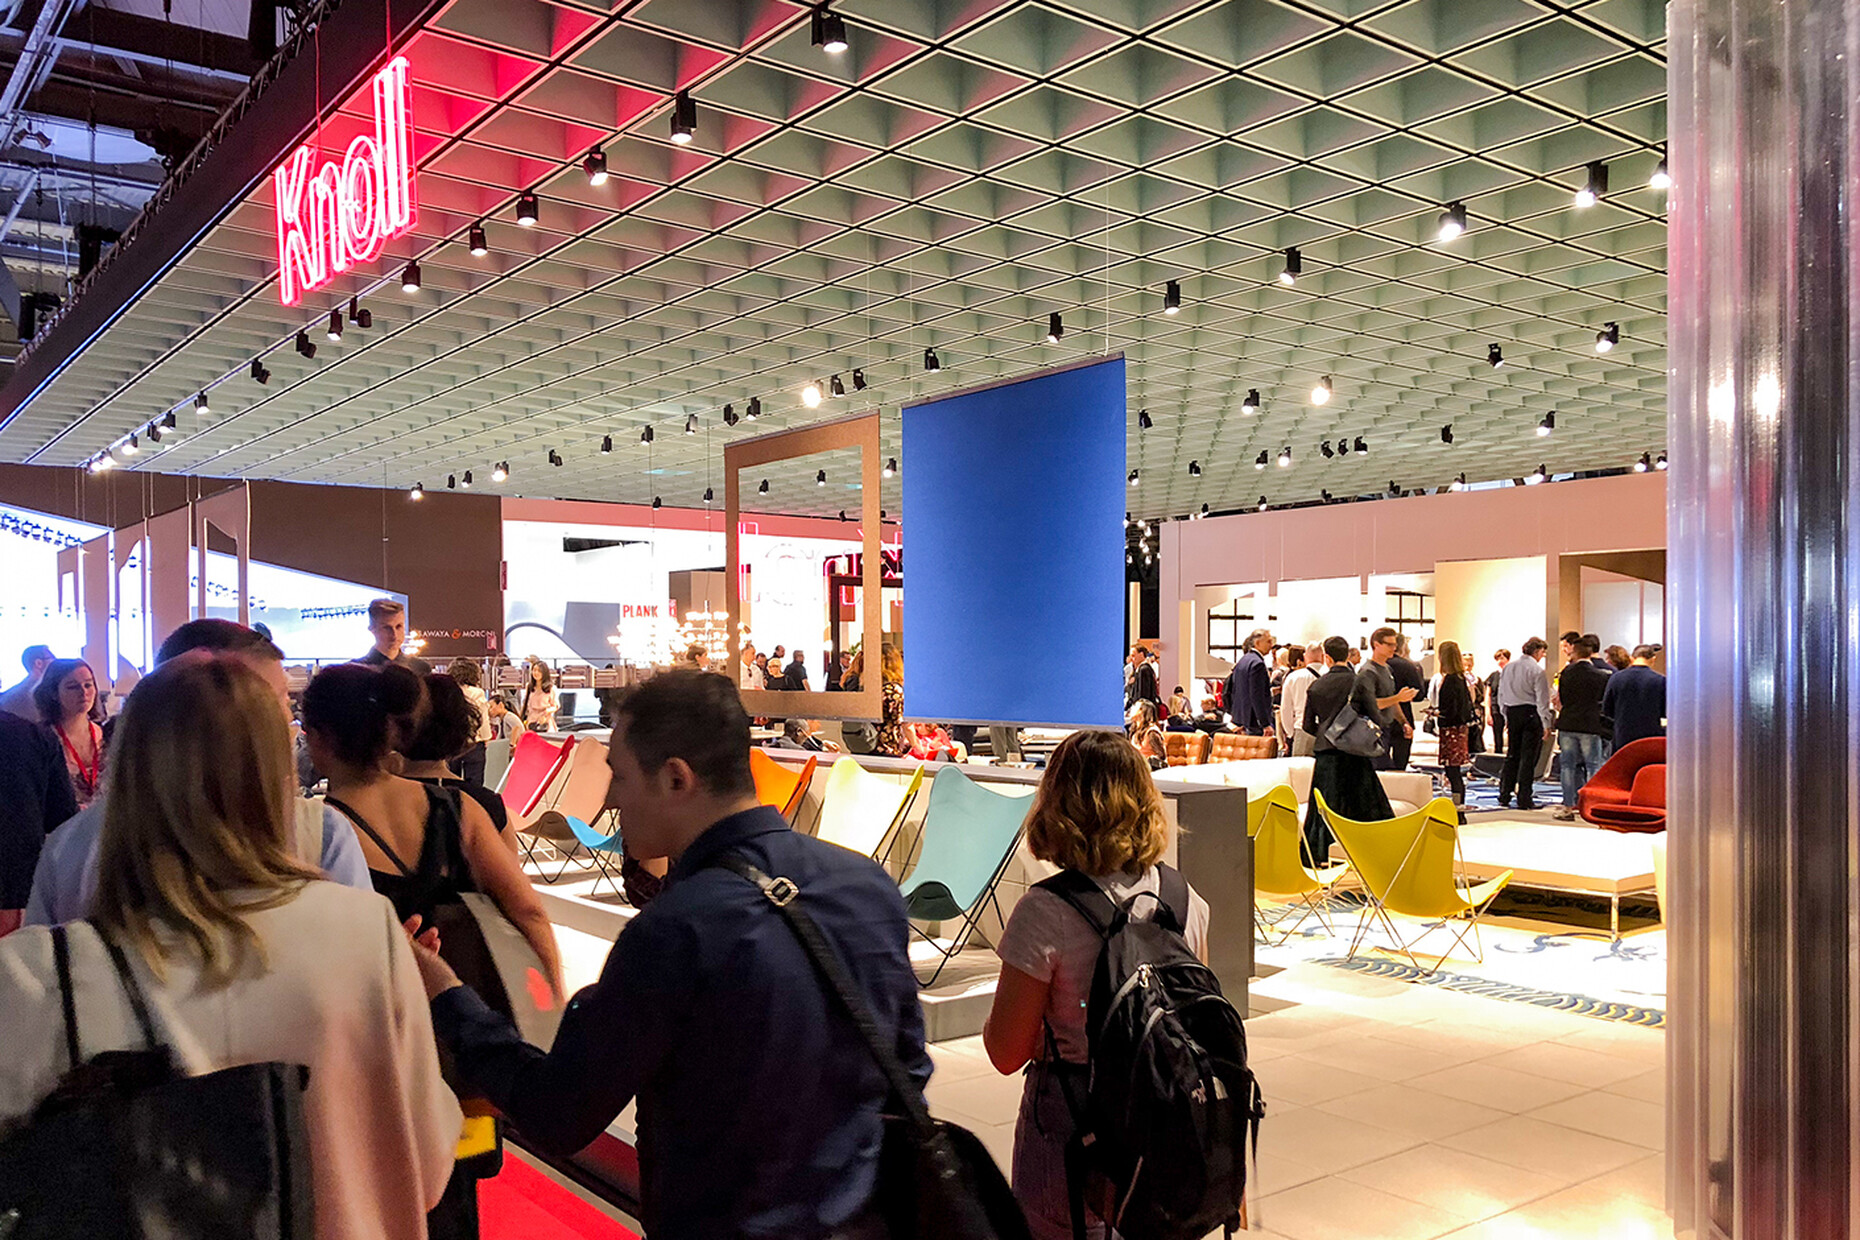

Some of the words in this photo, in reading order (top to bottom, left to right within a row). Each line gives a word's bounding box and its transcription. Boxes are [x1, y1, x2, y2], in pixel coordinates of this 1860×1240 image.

[274, 55, 415, 306] Knoll
[623, 604, 658, 618] PLANK
[452, 628, 461, 640] &
